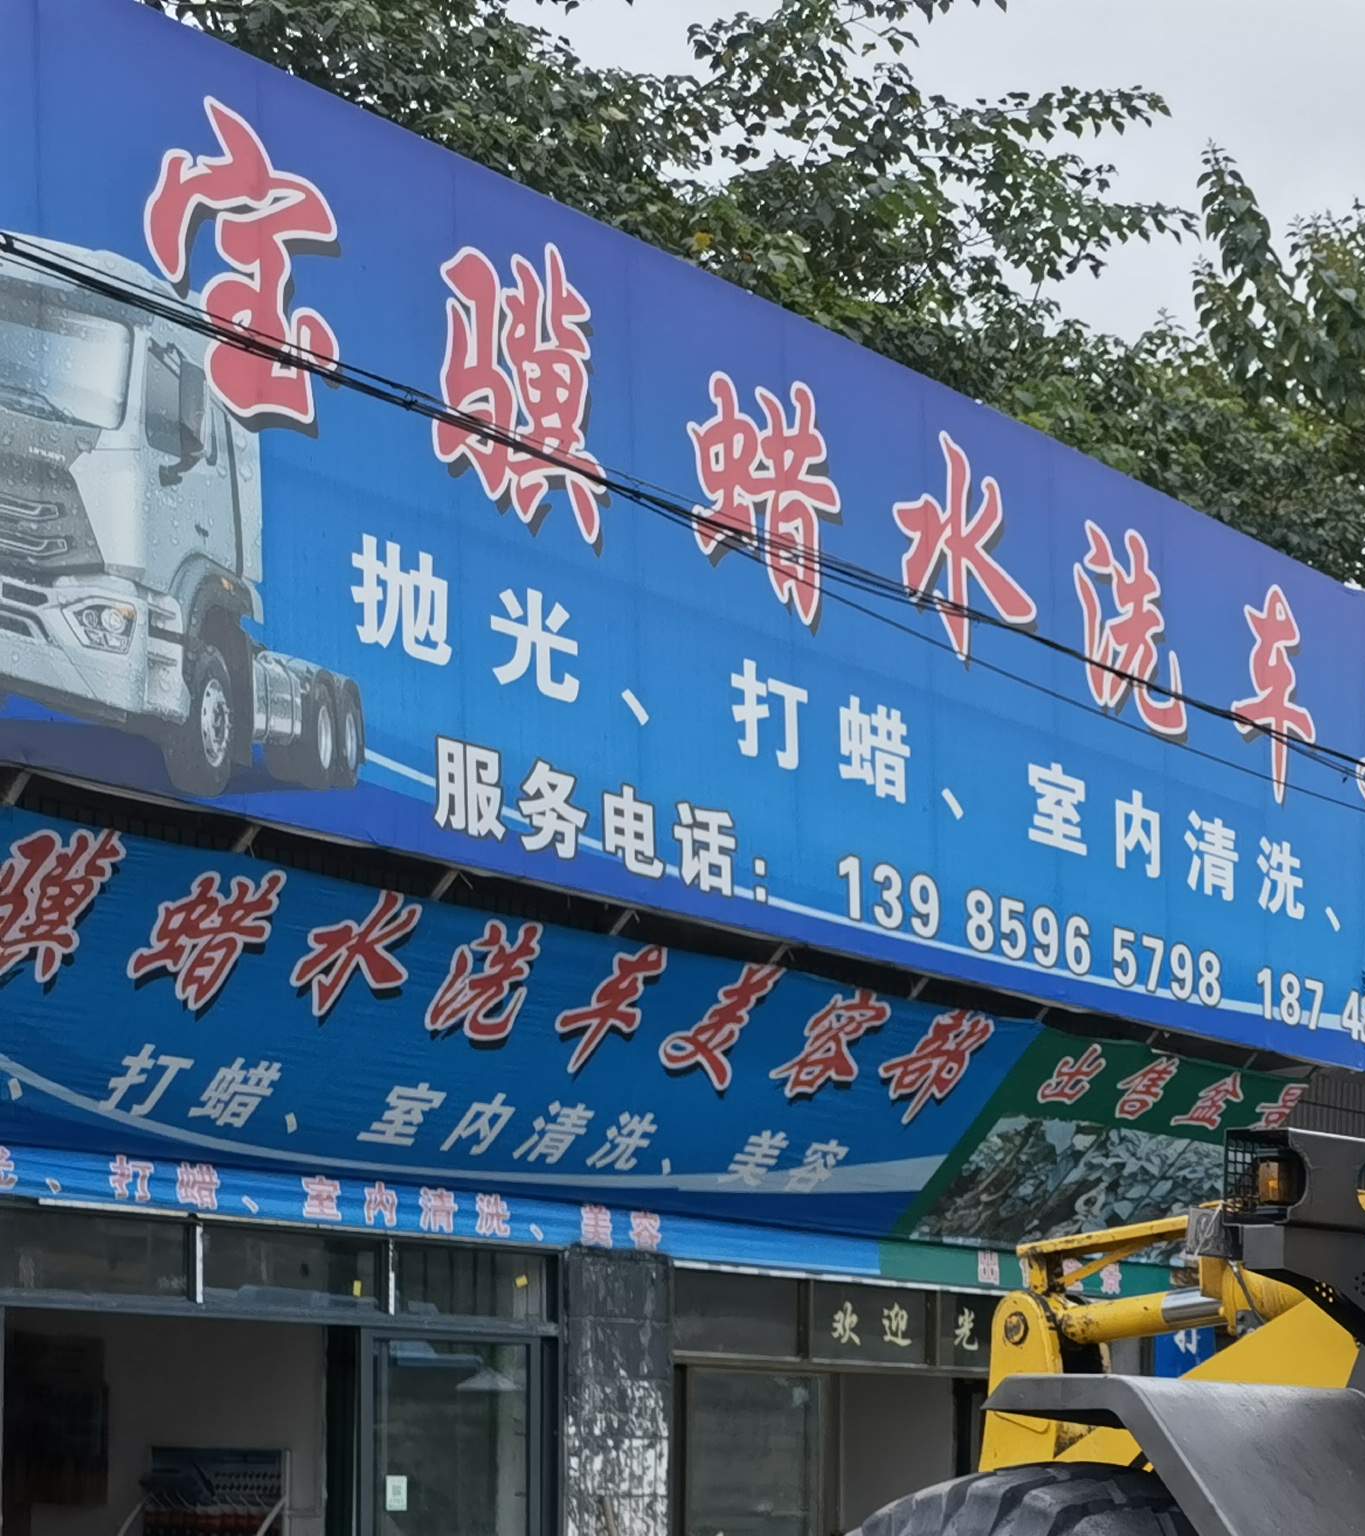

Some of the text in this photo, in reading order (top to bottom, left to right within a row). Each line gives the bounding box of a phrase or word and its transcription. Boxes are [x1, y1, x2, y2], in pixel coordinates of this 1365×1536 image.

[838, 854, 940, 939] 139
[965, 888, 1091, 977] 8596
[1112, 927, 1222, 1008] 5798
[1257, 967, 1324, 1030] 187
